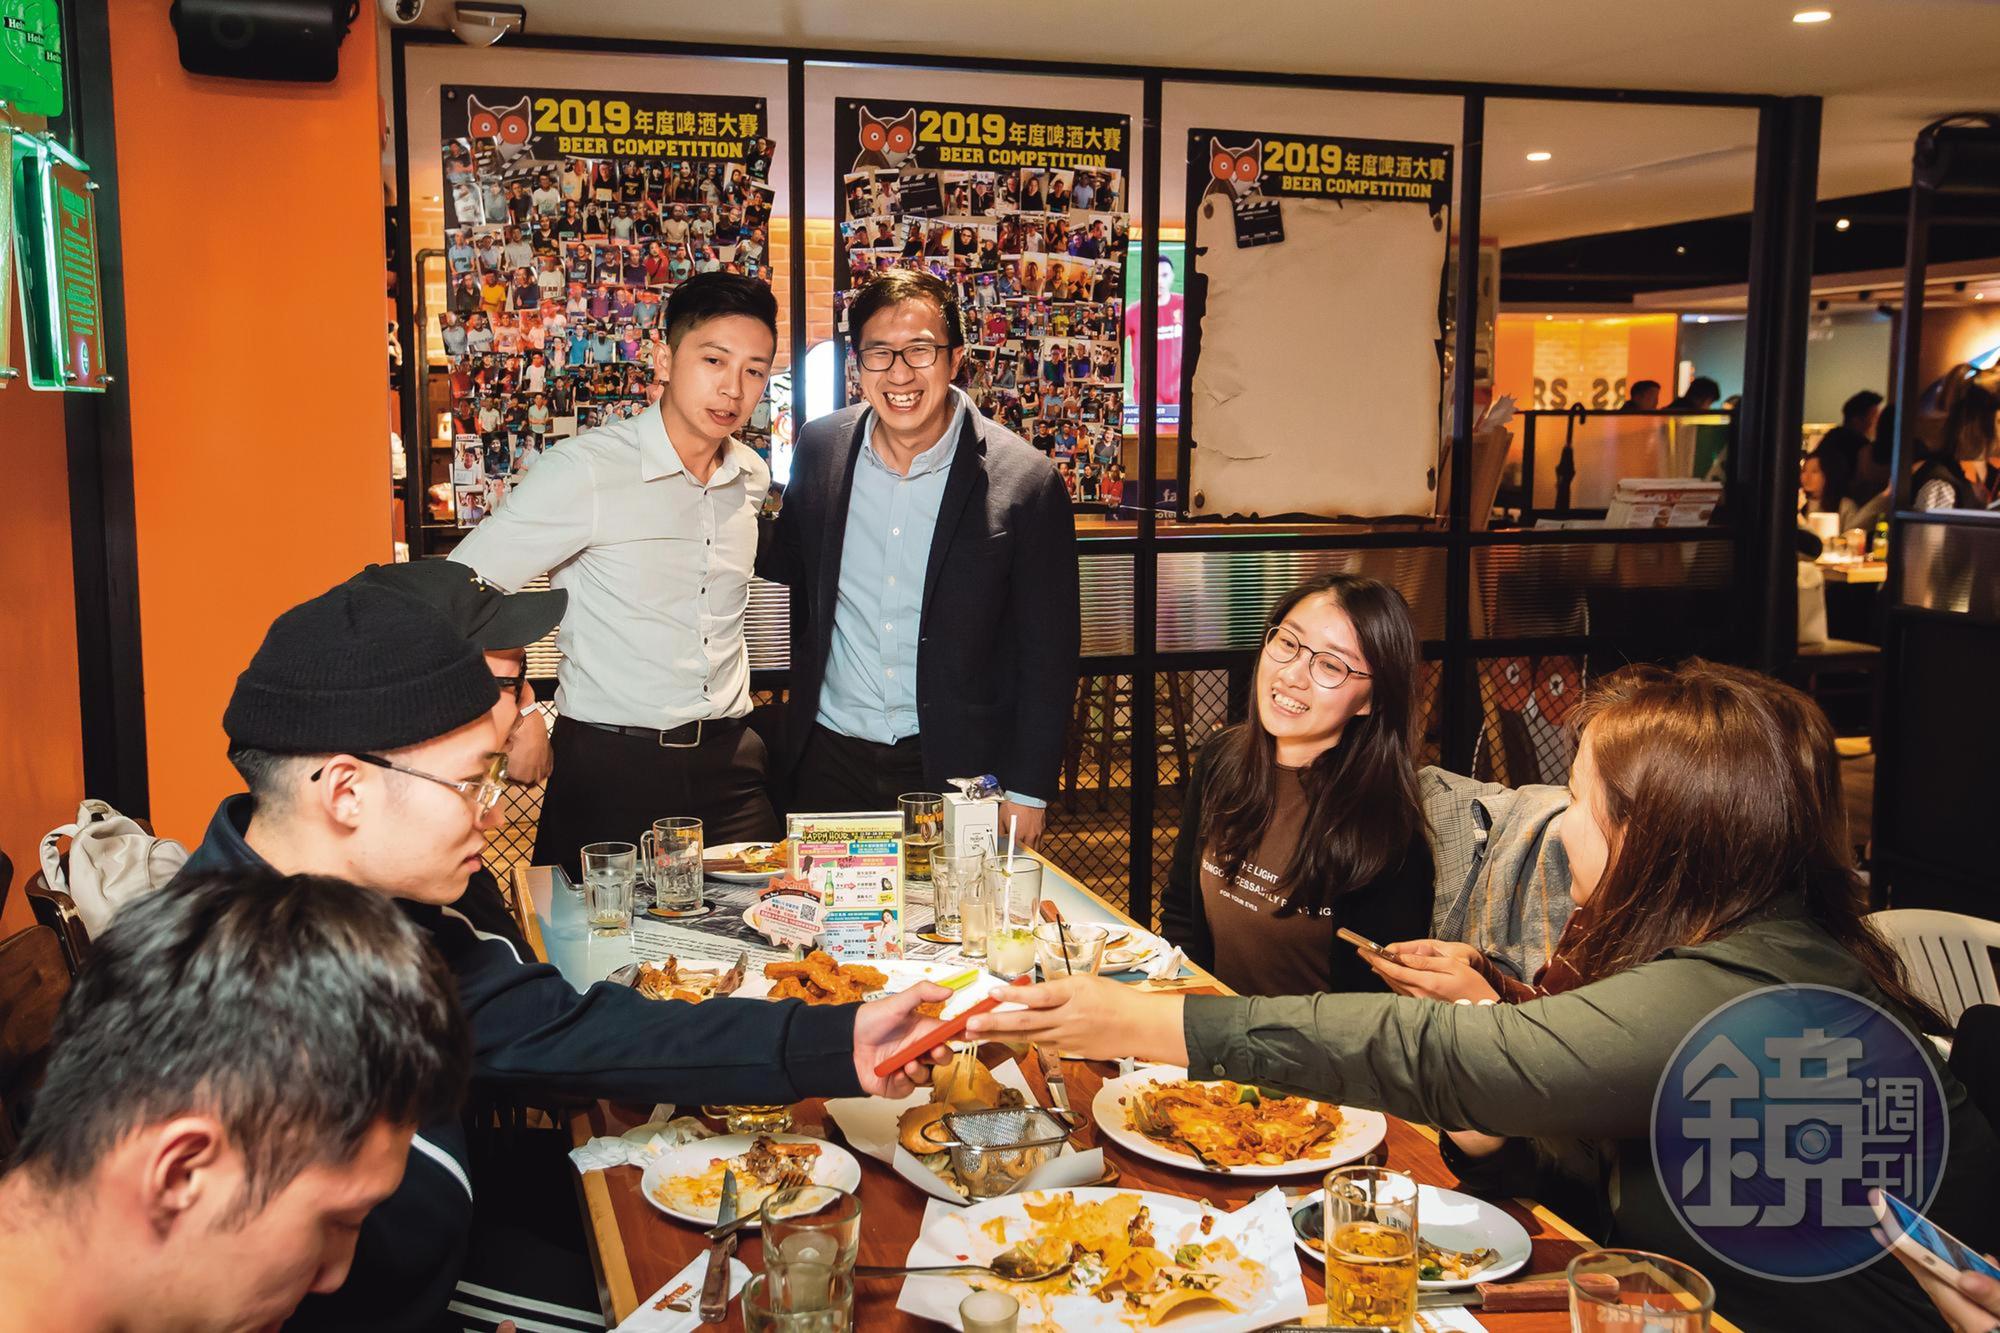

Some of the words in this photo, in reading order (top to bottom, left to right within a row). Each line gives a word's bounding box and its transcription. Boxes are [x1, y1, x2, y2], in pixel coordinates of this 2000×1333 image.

[558, 137, 612, 154] BEER
[616, 139, 743, 158] COMPETITION
[940, 147, 984, 163] BEER
[988, 149, 1106, 168] COMPETITION
[1282, 175, 1322, 192] BEER
[1326, 178, 1432, 198] COMPETITION
[802, 831, 829, 843] HAPPY
[829, 831, 849, 841] HOUR
[1253, 866, 1279, 884] LIGHT
